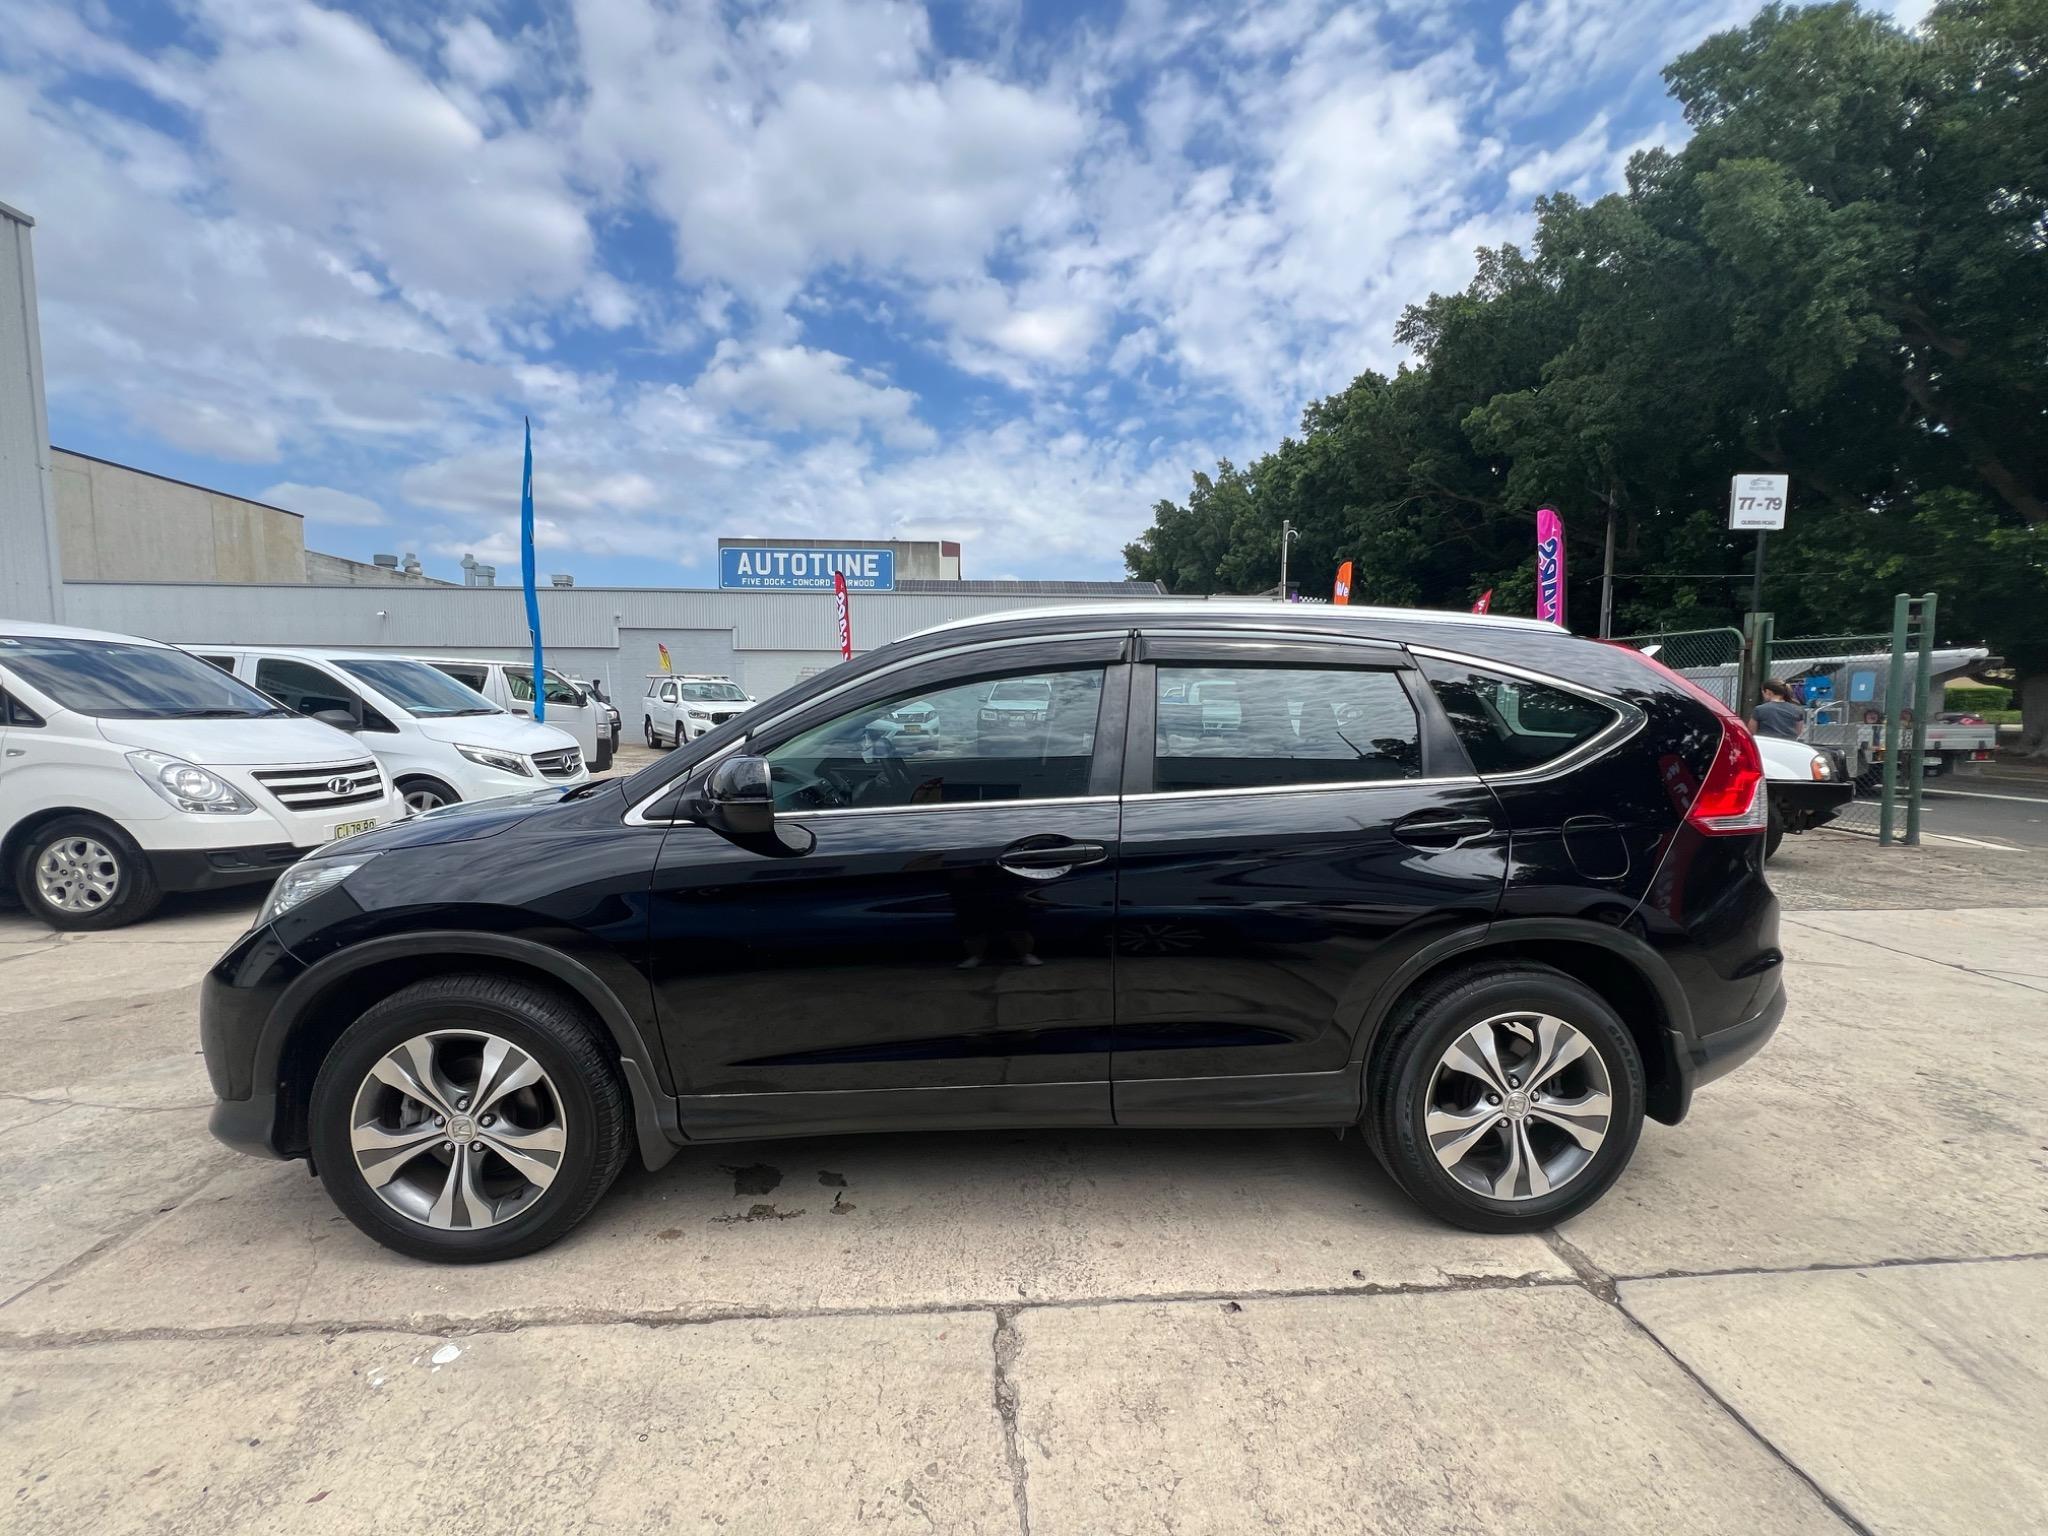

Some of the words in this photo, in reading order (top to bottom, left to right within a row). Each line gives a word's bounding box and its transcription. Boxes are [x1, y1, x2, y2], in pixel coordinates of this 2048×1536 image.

[737, 552, 880, 577] AUTOTUNE
[764, 578, 786, 586] DOCK
[846, 579, 875, 587] RWOOD
